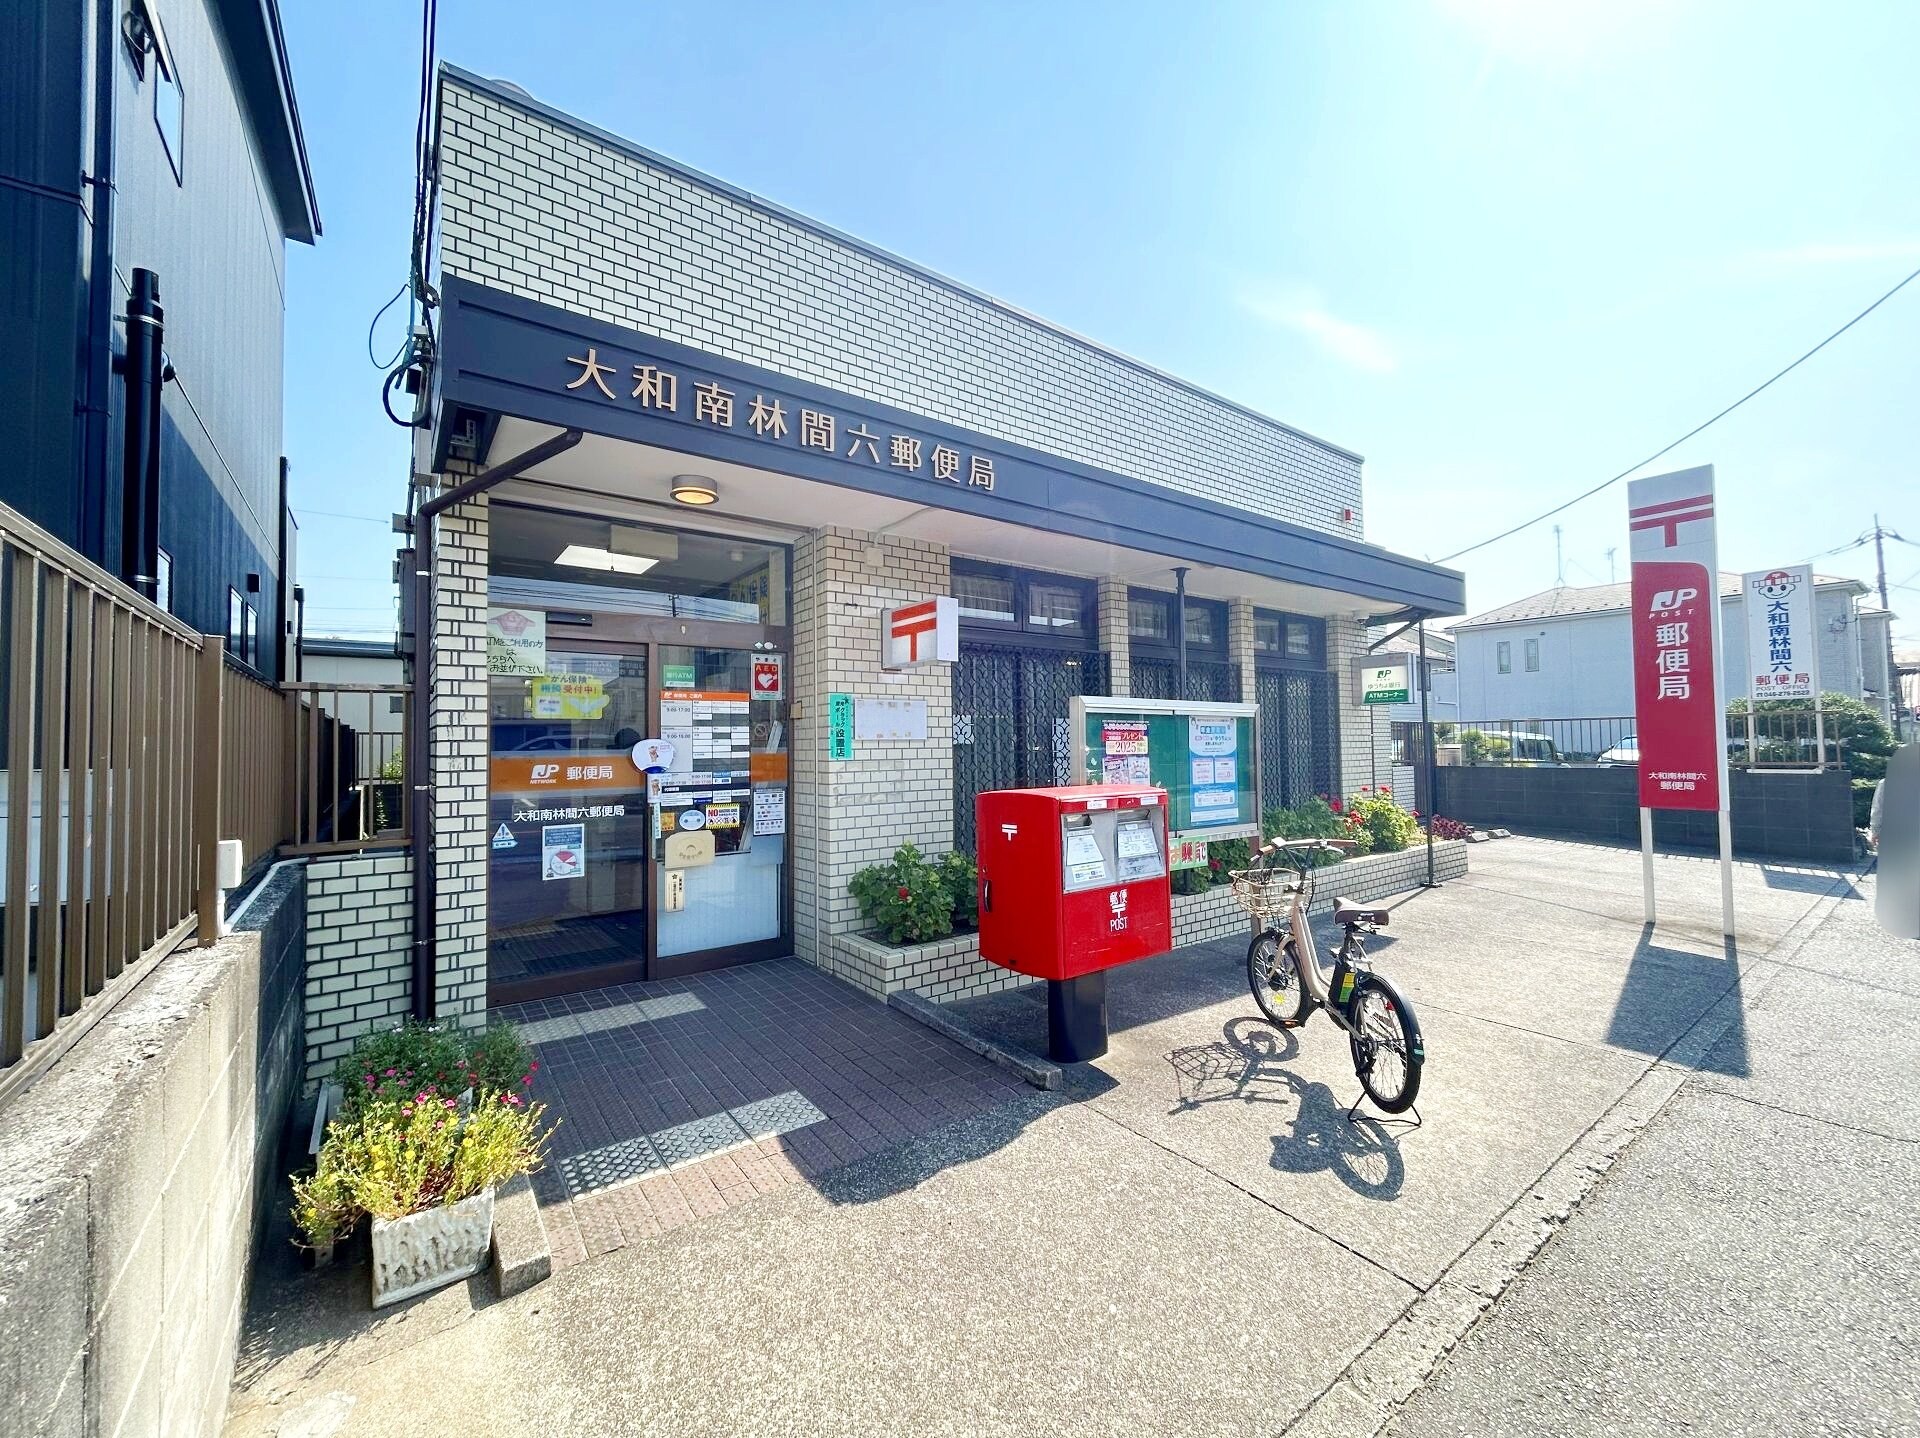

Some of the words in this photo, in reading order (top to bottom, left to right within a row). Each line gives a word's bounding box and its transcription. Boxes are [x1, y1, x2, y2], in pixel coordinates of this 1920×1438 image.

[565, 347, 996, 492] 大和南林間六郵便局
[1648, 608, 1695, 619] POST
[1767, 600, 1793, 673] 大和南林間六
[755, 664, 778, 672] AED
[1655, 622, 1690, 700] 郵便局
[1755, 673, 1810, 686] 郵便局
[1368, 691, 1405, 699] ATMコーナー
[1115, 741, 1137, 753] 2025
[566, 765, 613, 781] 郵便局
[1648, 771, 1708, 781] 大和南林間六
[1660, 780, 1696, 791] 郵便局
[513, 804, 625, 823] 大和南林間六郵便局
[1109, 888, 1128, 907] 郵便
[1110, 916, 1129, 932] POST
